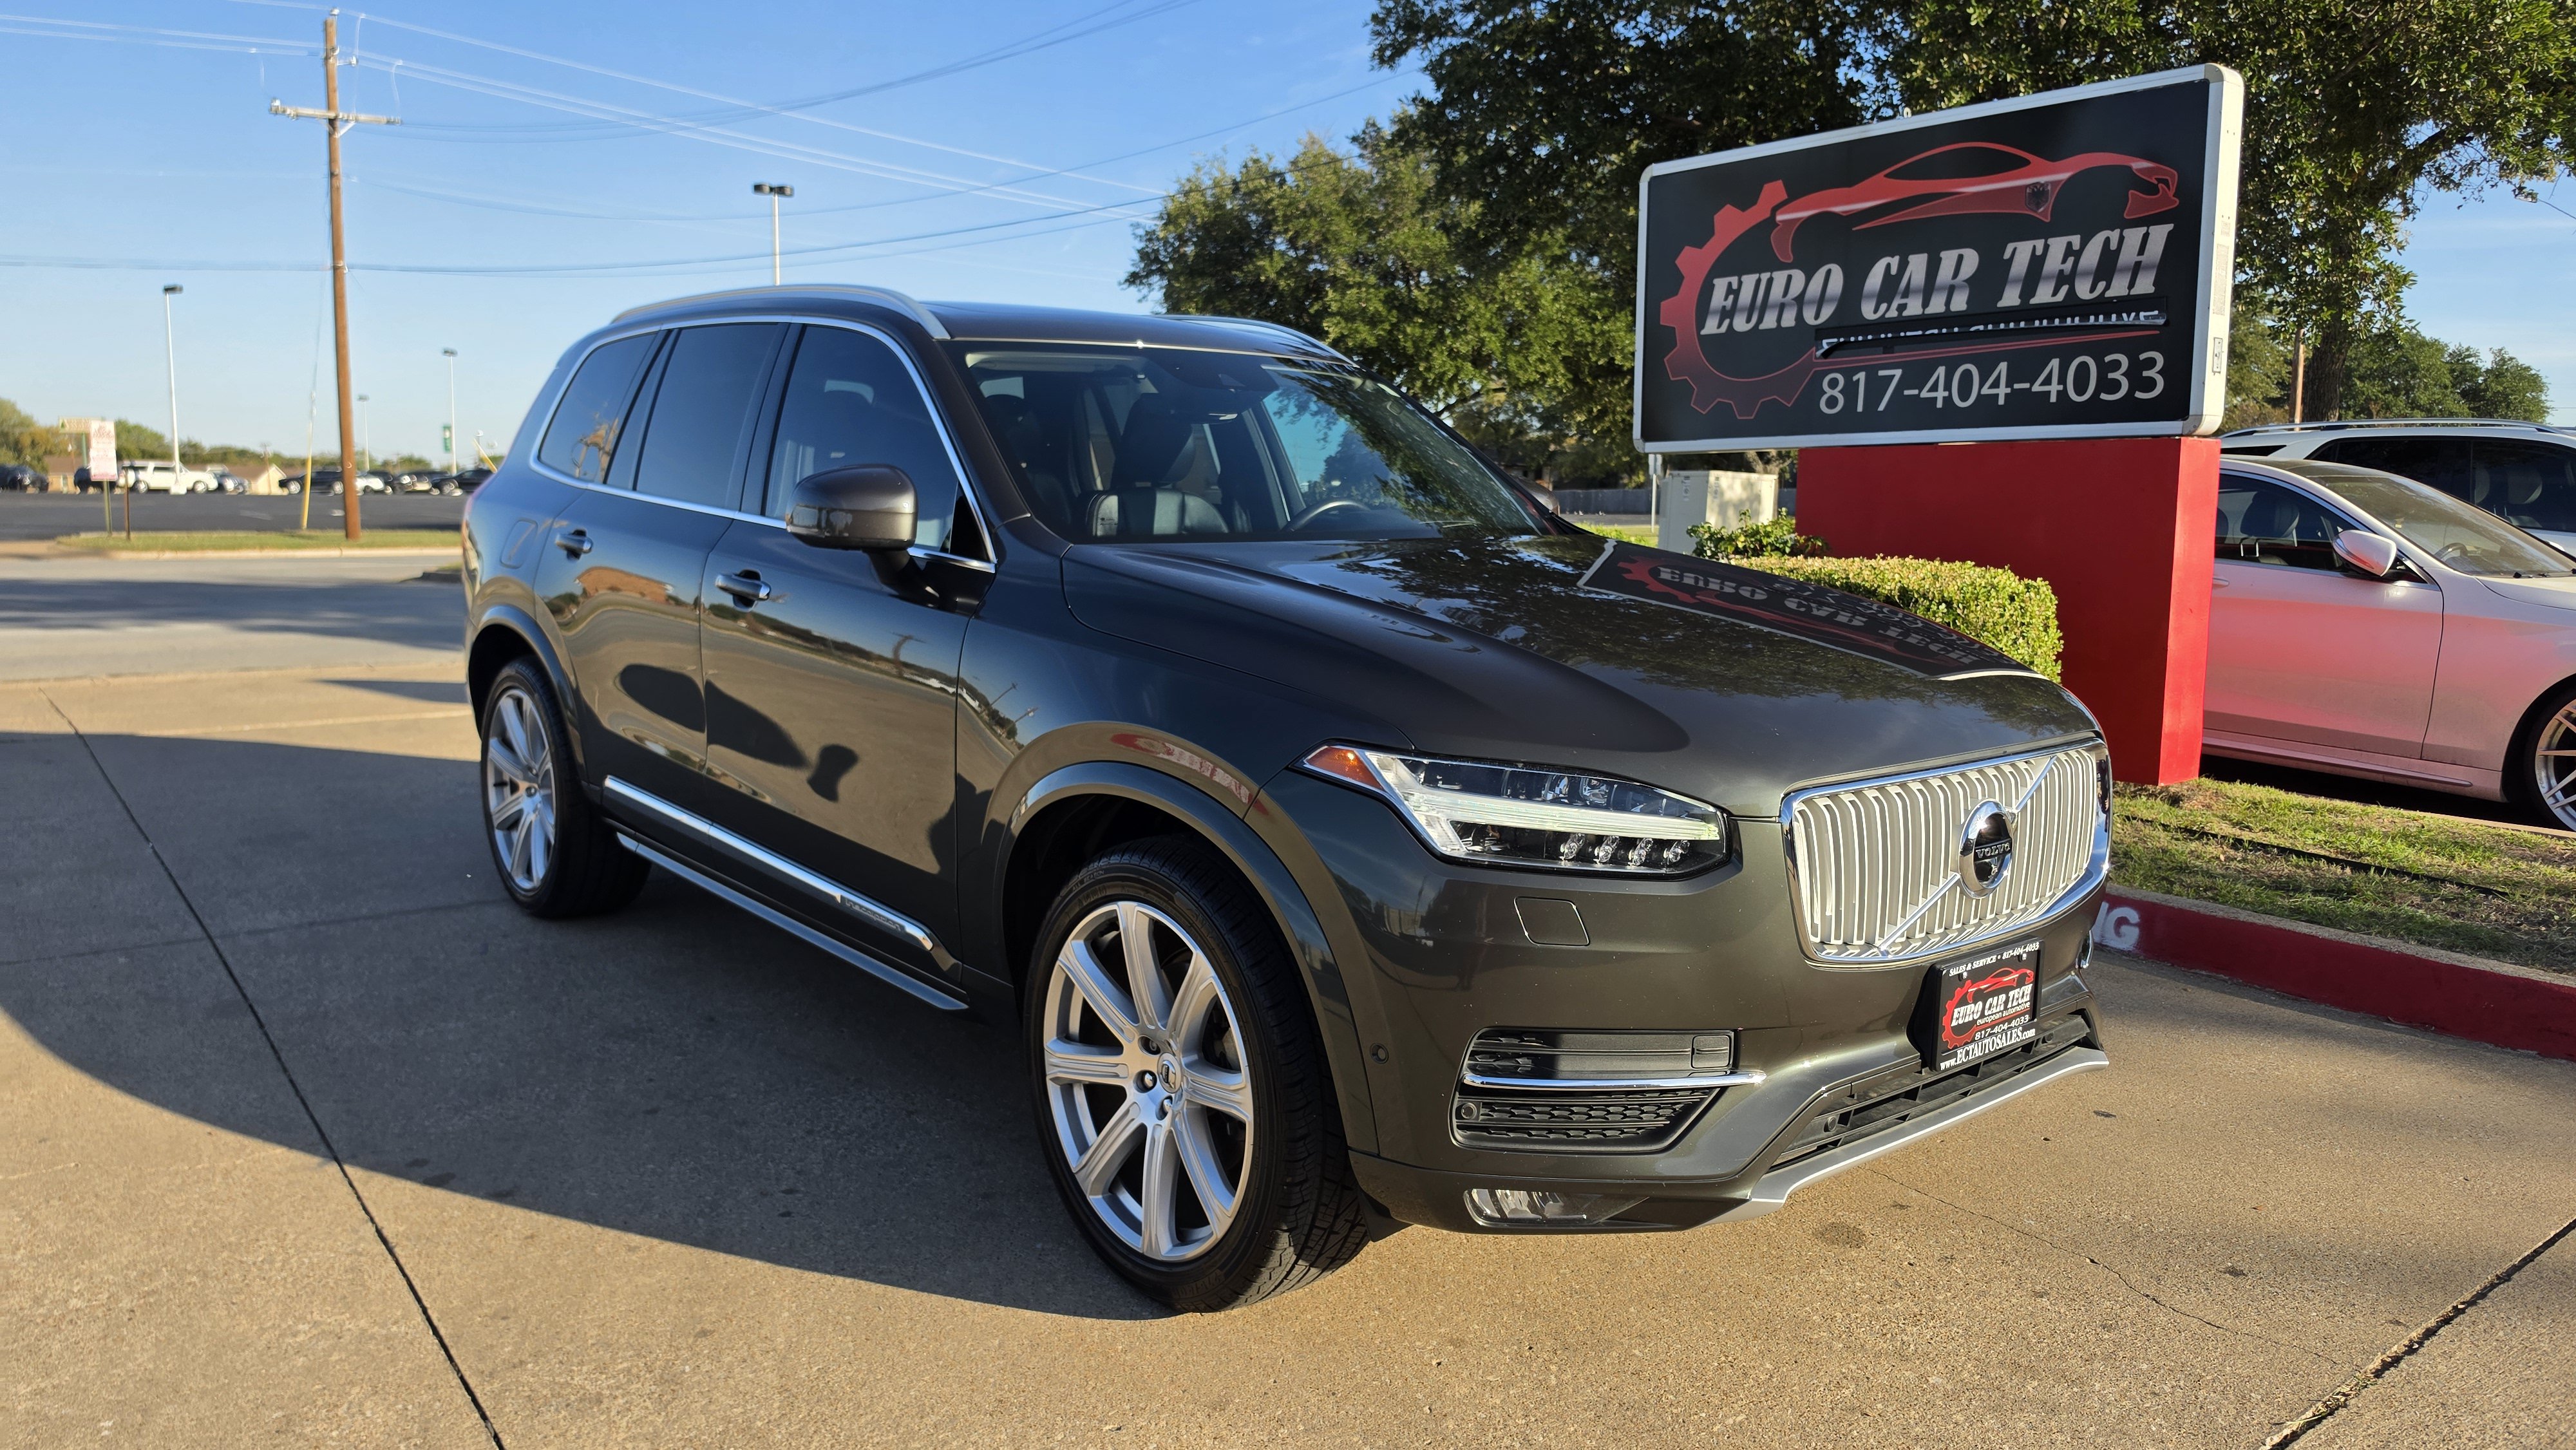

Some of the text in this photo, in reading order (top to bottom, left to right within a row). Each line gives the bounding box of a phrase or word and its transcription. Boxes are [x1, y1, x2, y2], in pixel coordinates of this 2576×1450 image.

[1700, 263, 1844, 335] EURO
[1861, 247, 1980, 321] CAR
[1997, 223, 2174, 306] TECH
[1819, 351, 2164, 415] 817-404-4033
[1976, 843, 2010, 858] VOLVO
[1949, 965, 1966, 976] SALES
[1972, 955, 1996, 968] SERVICE
[2002, 942, 2039, 959] 817-404-4033
[1951, 984, 2032, 1026] EURO CAR TECH
[1976, 1001, 2031, 1025] european automotive
[1975, 1015, 2029, 1040] 817-404-4033
[1940, 1027, 2036, 1070] www.ECTAUTOSALES.com
